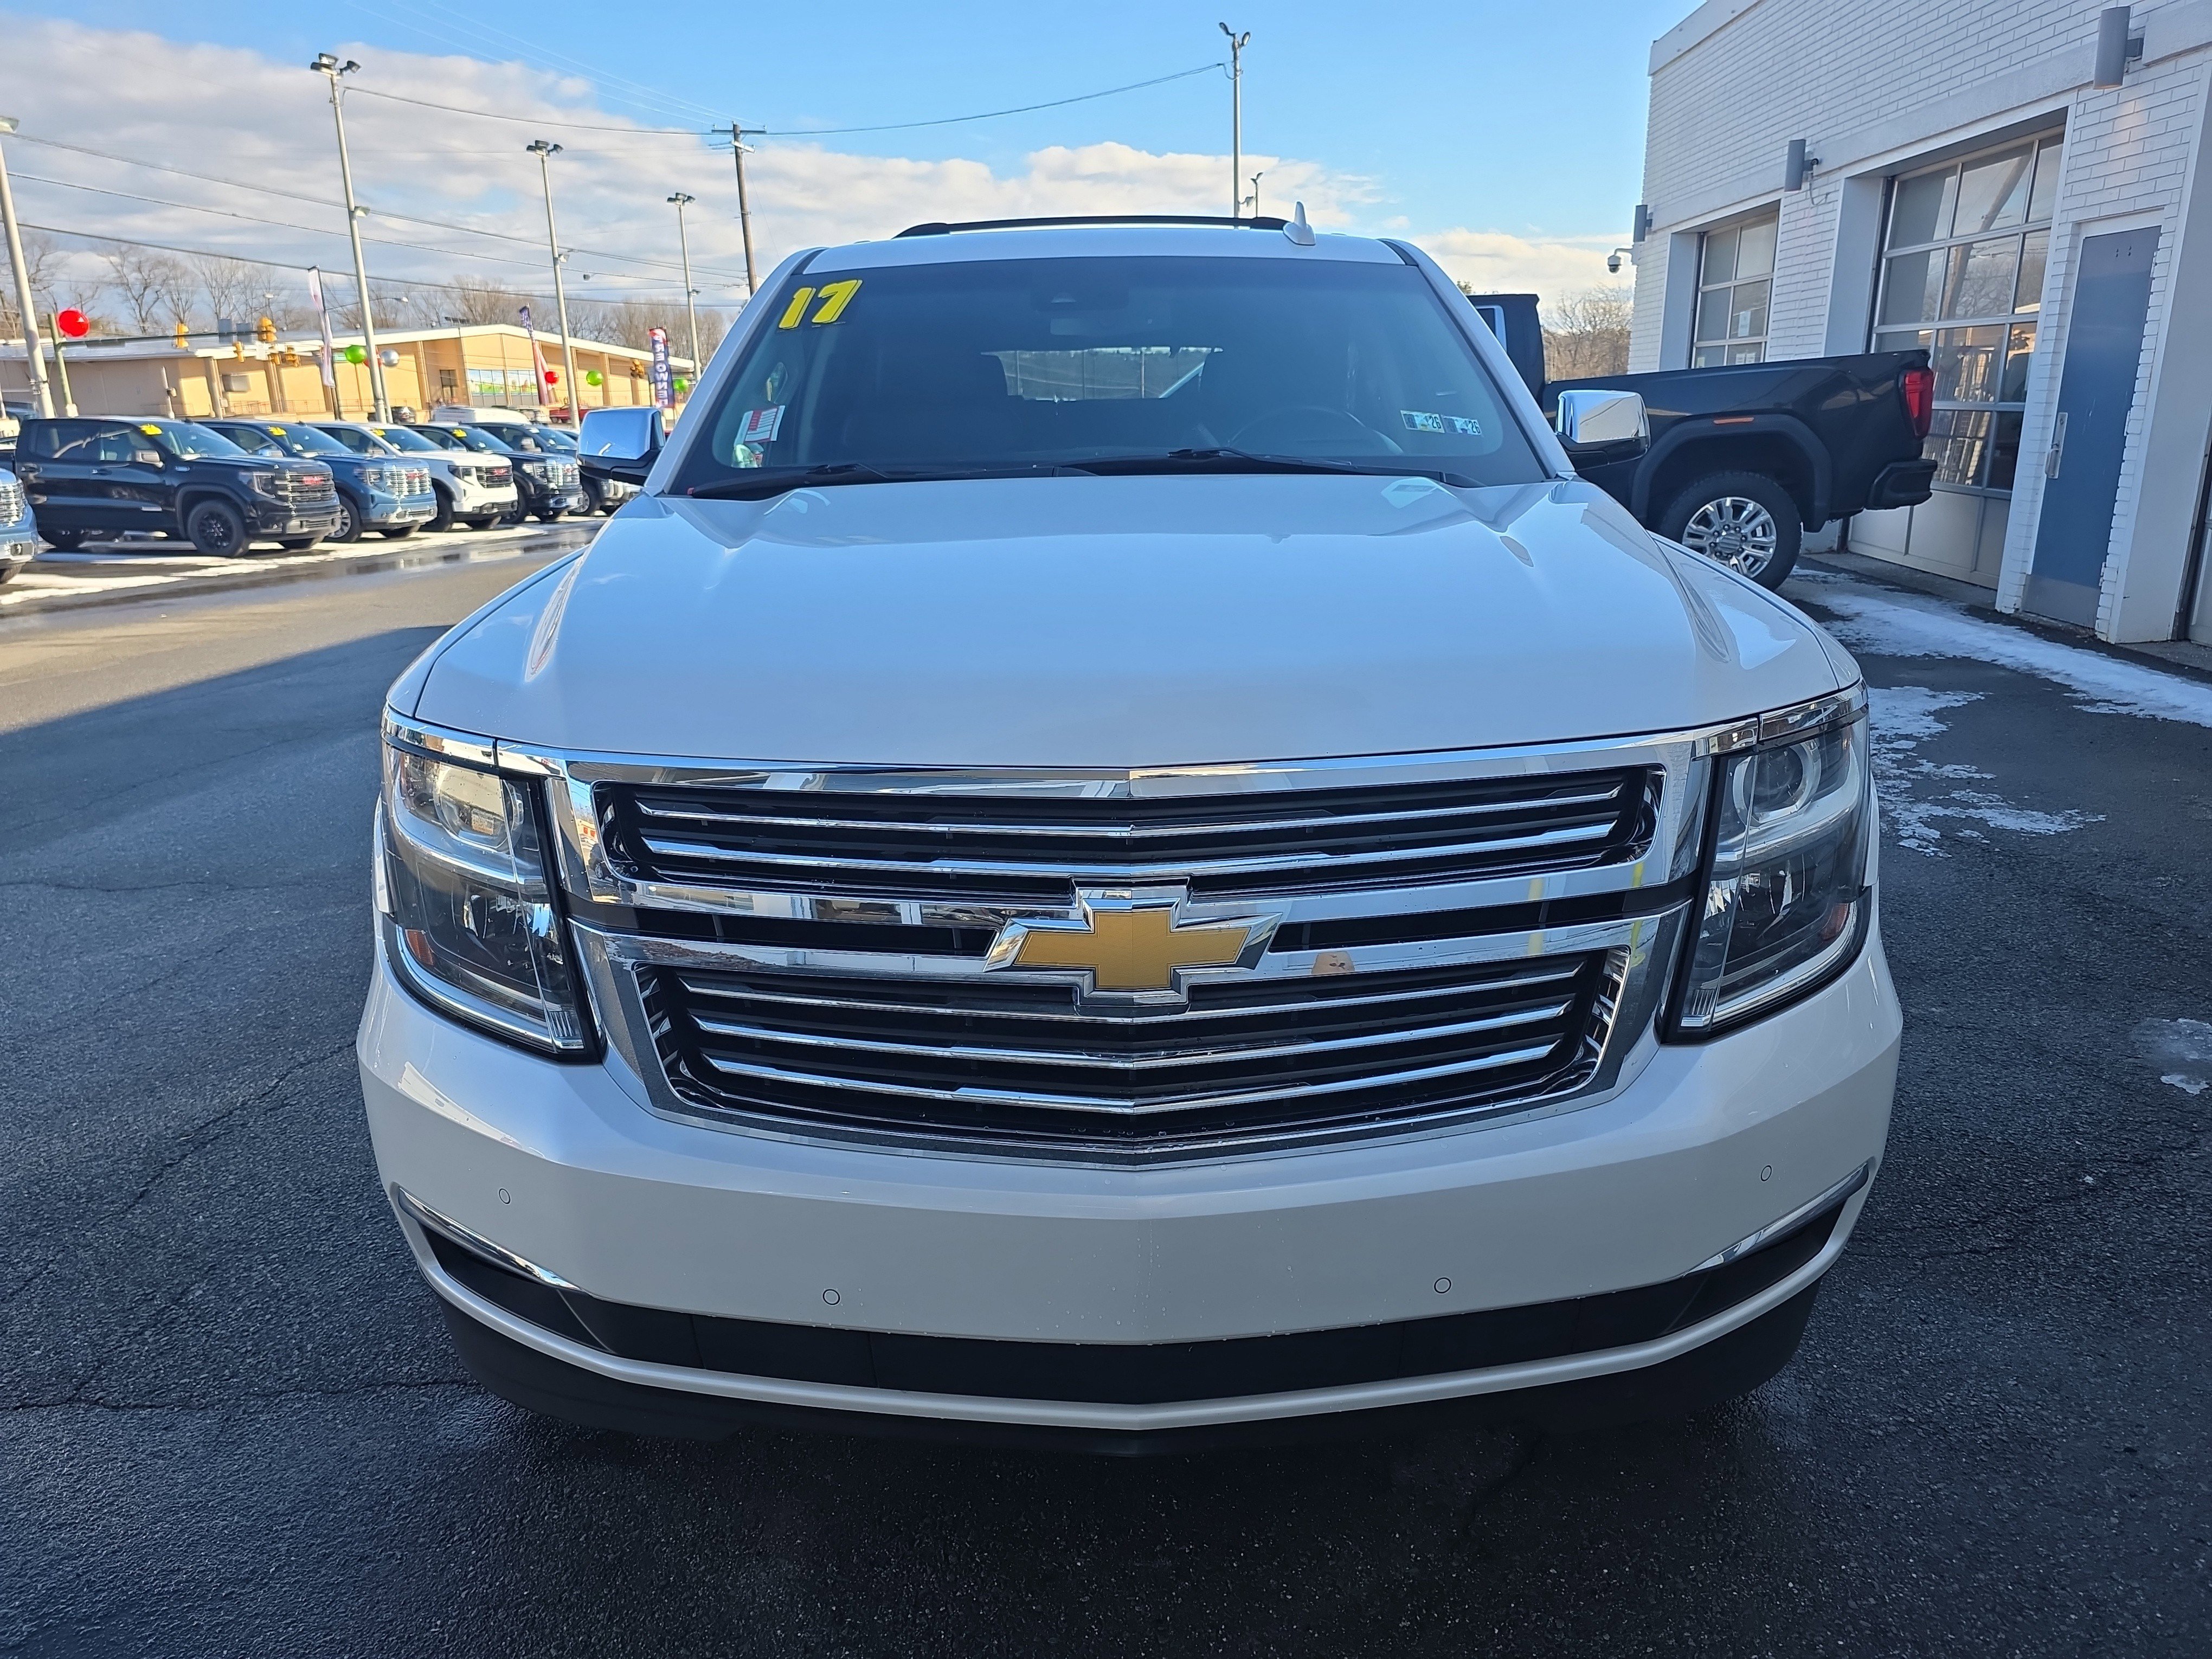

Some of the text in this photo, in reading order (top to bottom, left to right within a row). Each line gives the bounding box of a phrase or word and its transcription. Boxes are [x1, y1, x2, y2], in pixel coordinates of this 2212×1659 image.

[778, 279, 863, 329] 17
[1429, 416, 1442, 429] 26
[1469, 420, 1481, 434] 26
